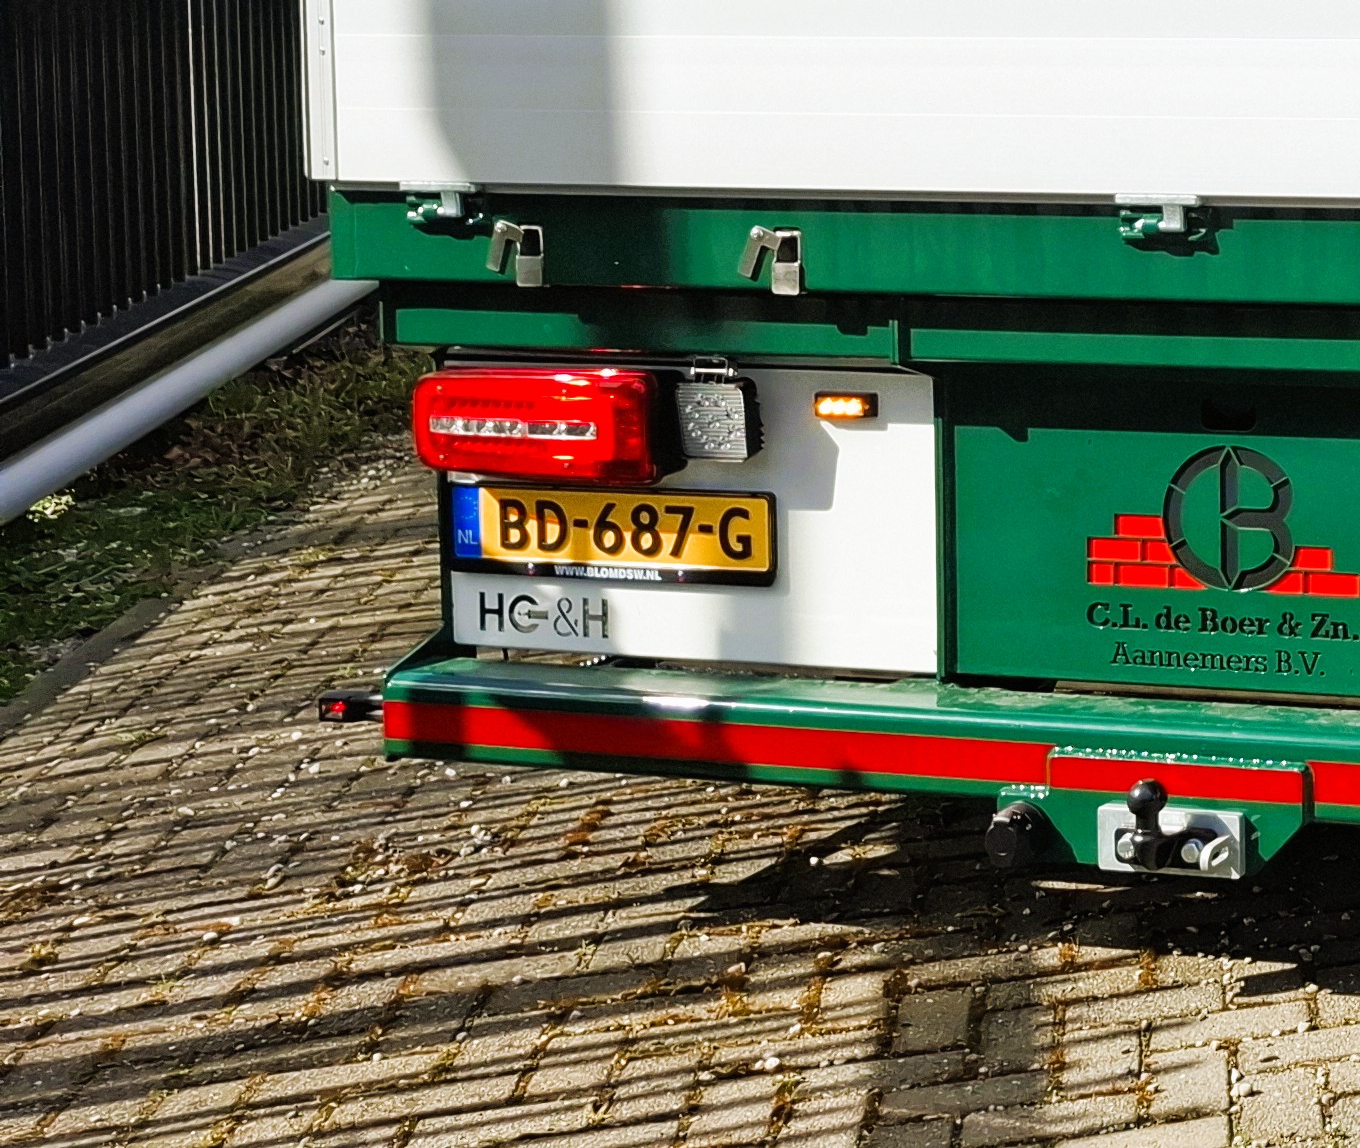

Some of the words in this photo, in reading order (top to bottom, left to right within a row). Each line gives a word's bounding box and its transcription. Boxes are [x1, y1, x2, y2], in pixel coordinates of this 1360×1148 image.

[457, 529, 478, 545] NL
[499, 499, 753, 561] BD-687-G
[554, 565, 662, 581] WWW.BLOMDSW.NL
[1086, 602, 1149, 630] C.L.
[1154, 606, 1191, 632] de
[1198, 607, 1271, 636] Boer
[1276, 612, 1303, 638] &
[1310, 613, 1360, 641] Zn.
[1110, 642, 1268, 675] Aannemers
[1275, 650, 1326, 677] B.V.
